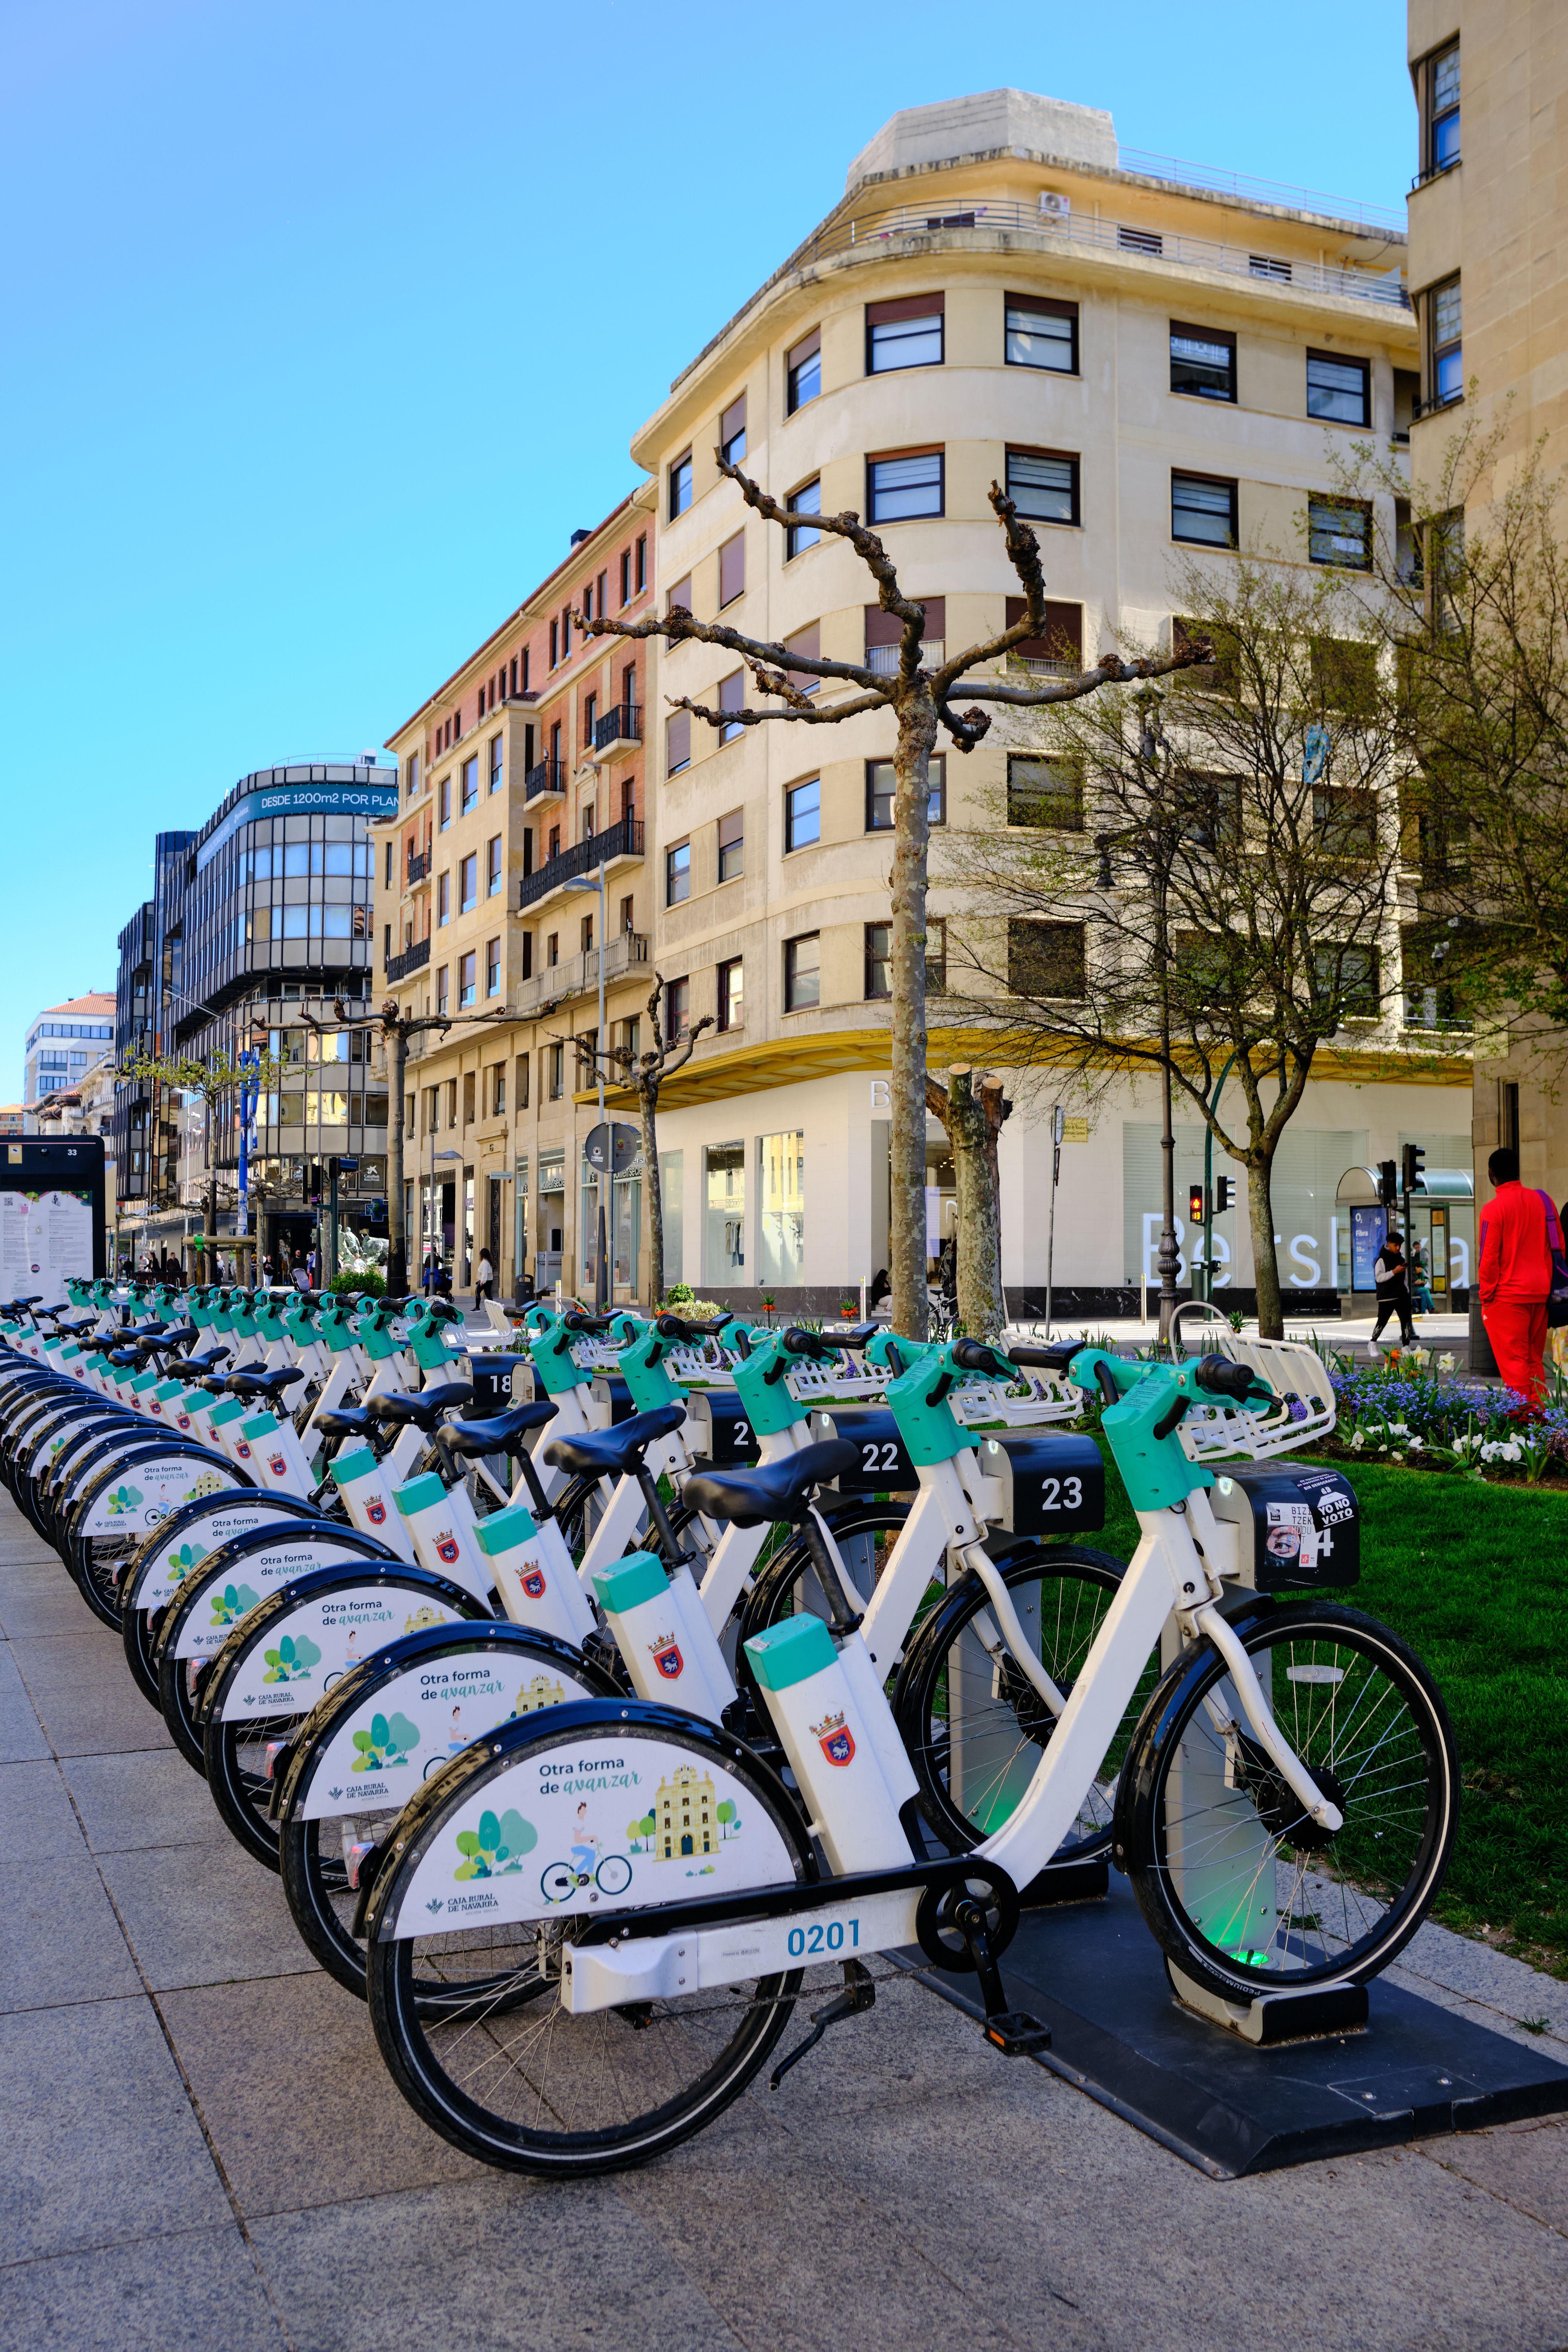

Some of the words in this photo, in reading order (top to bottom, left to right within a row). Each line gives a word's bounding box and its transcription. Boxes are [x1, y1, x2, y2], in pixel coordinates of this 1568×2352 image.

[262, 795, 291, 808] DESDE
[293, 793, 339, 804] 1200m2
[342, 793, 369, 805] POR
[490, 1143, 494, 1152] 5
[490, 1375, 511, 1393] 18
[734, 1421, 758, 1445] 2
[862, 1443, 898, 1472] 22
[155, 1472, 190, 1481] avanzar
[1311, 1478, 1338, 1488] DEMOCRACIA
[1042, 1476, 1082, 1510] 23
[1291, 1507, 1312, 1515] BIZI
[1318, 1504, 1334, 1515] YO
[1334, 1498, 1350, 1510] NO
[1292, 1516, 1312, 1525] TZEK
[1321, 1508, 1353, 1525] VOTO
[284, 1554, 312, 1563] forma
[322, 1604, 346, 1613] Otra
[349, 1601, 382, 1611] forma
[323, 1616, 336, 1625] de
[339, 1610, 395, 1626] avanzar
[420, 1675, 449, 1685] Otra
[452, 1670, 490, 1681] forma
[421, 1689, 437, 1700] de
[440, 1680, 505, 1700] avanzar
[539, 1764, 573, 1776] Otra
[579, 1759, 624, 1772] forma
[540, 1782, 559, 1794] de
[563, 1771, 642, 1795] avanzar
[358, 1788, 389, 1797] NAVARRA
[461, 1900, 499, 1911] NAVARRA
[469, 1893, 495, 1903] RURAL
[788, 1919, 859, 1957] 0201
